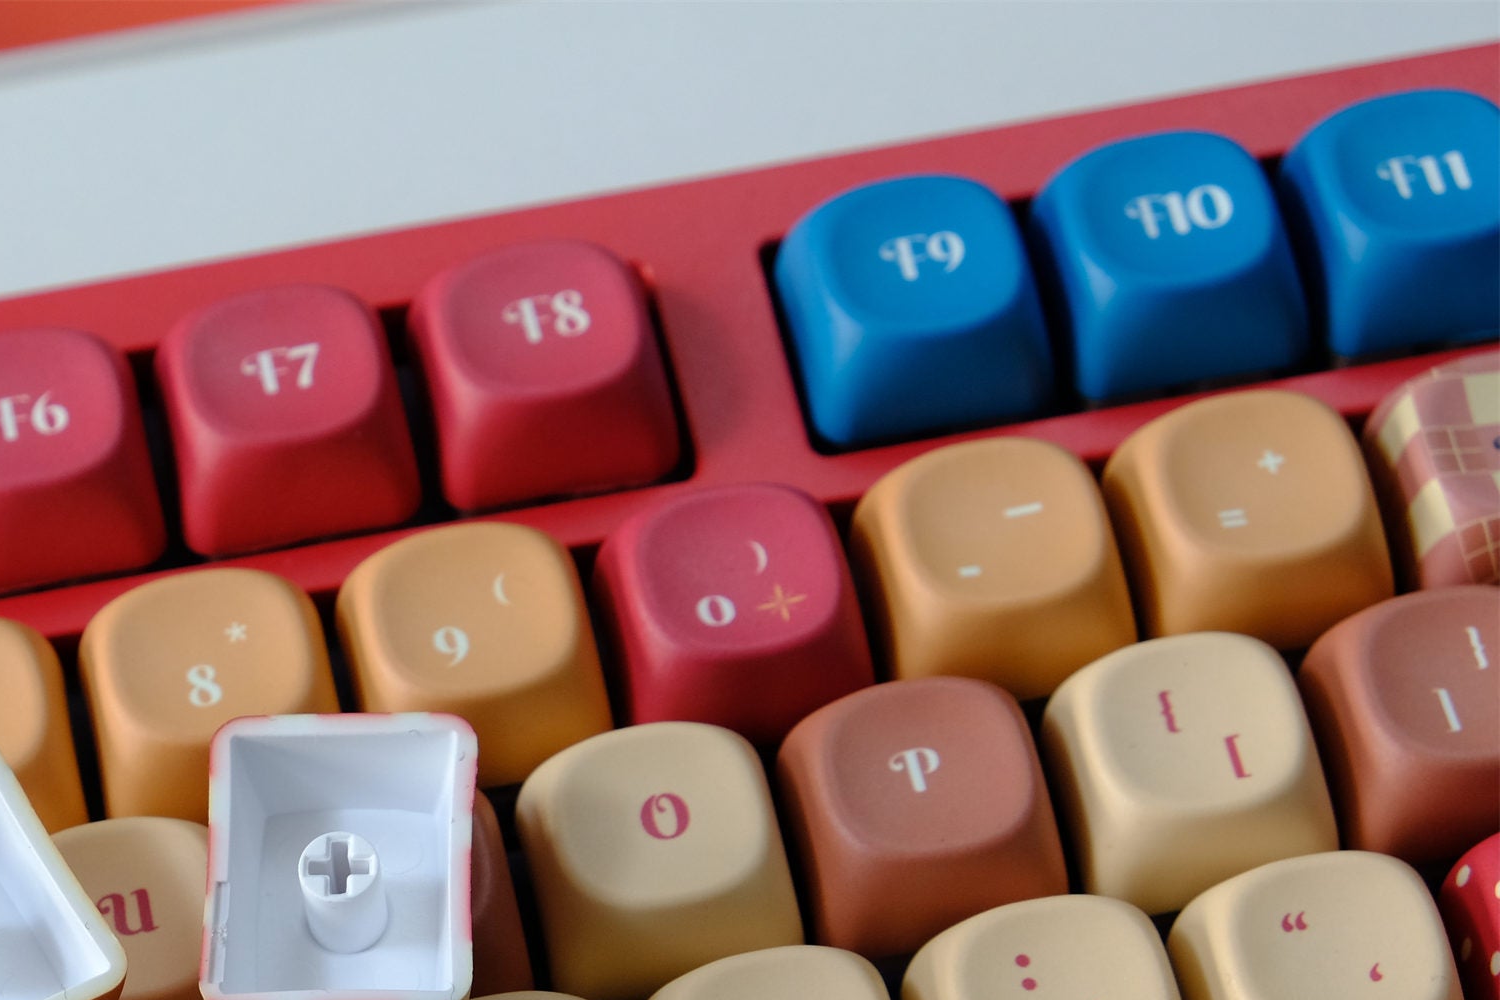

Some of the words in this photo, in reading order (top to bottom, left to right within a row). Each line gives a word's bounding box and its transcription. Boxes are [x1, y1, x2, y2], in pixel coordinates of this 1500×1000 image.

[1377, 151, 1472, 199] F11
[1127, 185, 1233, 238] F10
[880, 231, 965, 281] F9
[504, 291, 590, 343] F8
[242, 343, 319, 394] F7
[1258, 450, 1284, 473] +
[1218, 508, 1248, 528] =
[433, 627, 469, 665] 9
[187, 665, 222, 707] 8
[889, 748, 940, 792] P
[640, 793, 690, 840] O
